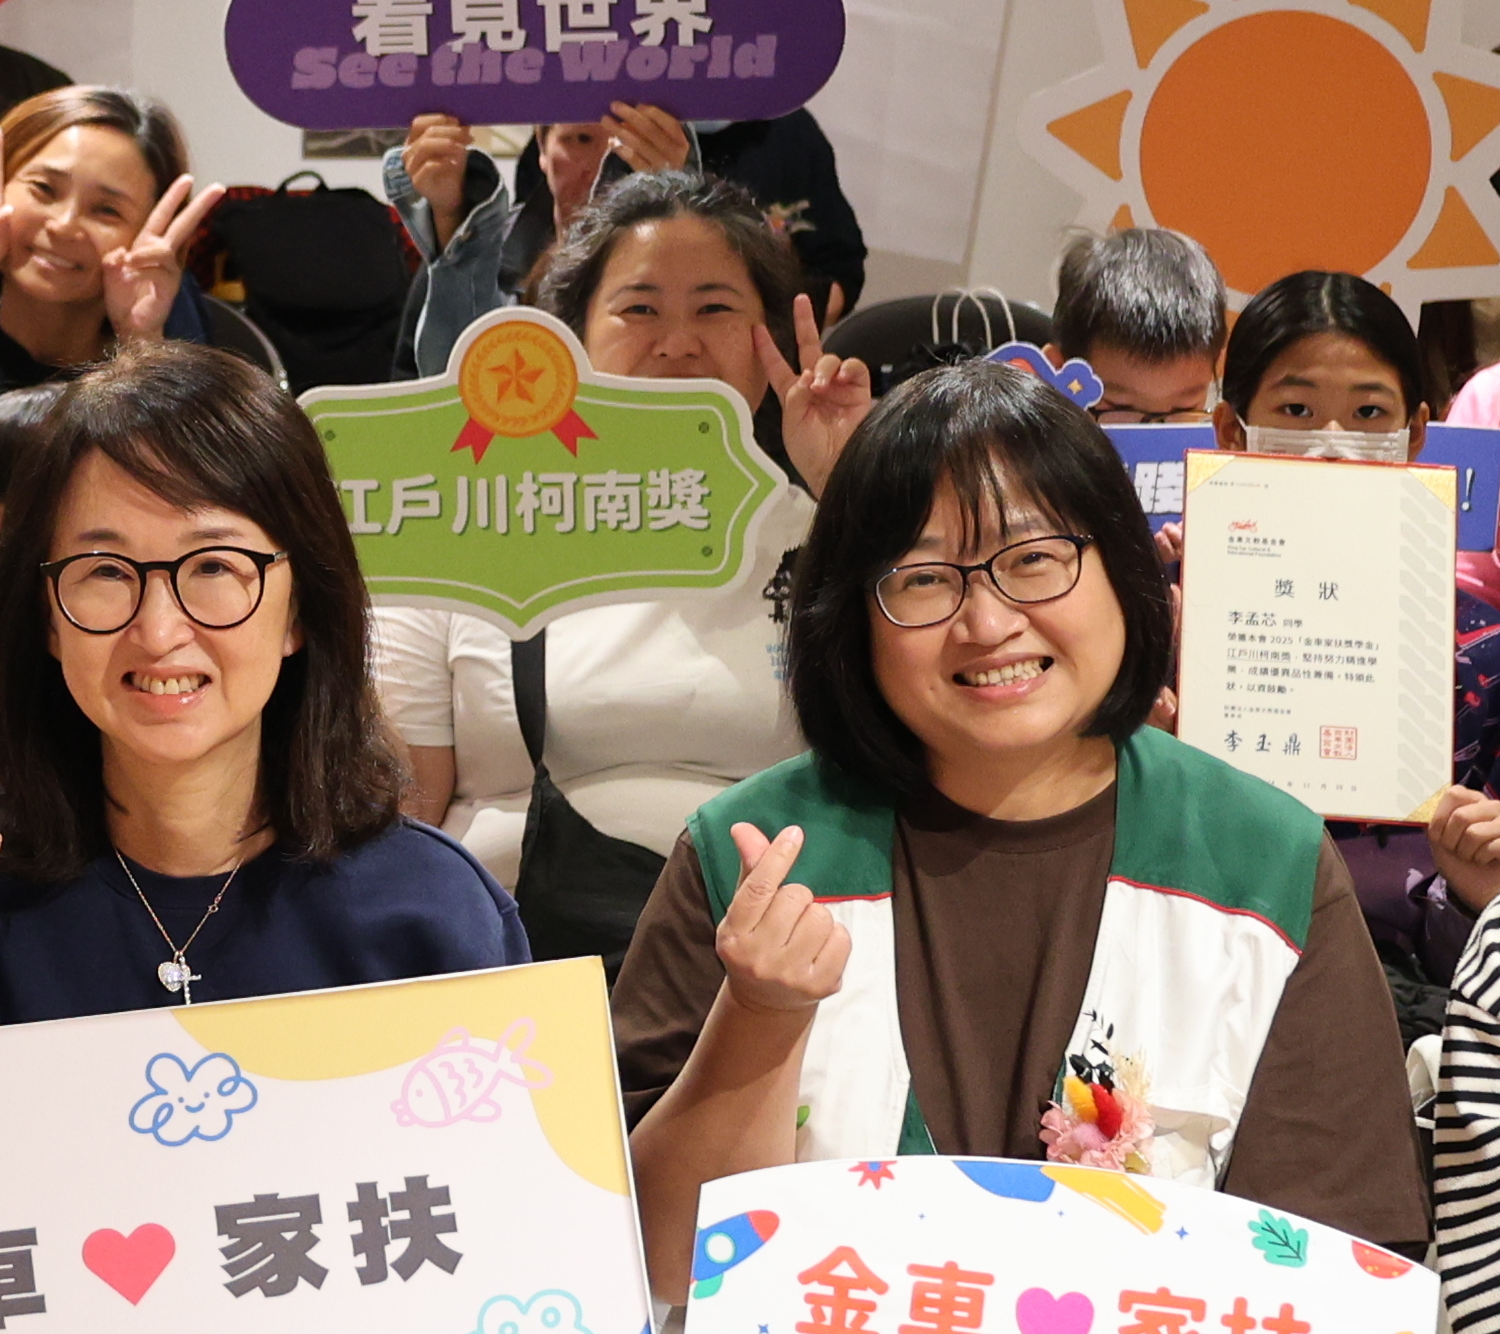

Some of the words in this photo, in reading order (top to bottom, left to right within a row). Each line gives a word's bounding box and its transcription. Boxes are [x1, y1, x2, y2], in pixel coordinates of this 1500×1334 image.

[291, 45, 415, 90] See
[430, 41, 545, 87] the
[561, 34, 777, 83] World
[214, 1174, 462, 1300] 家扶
